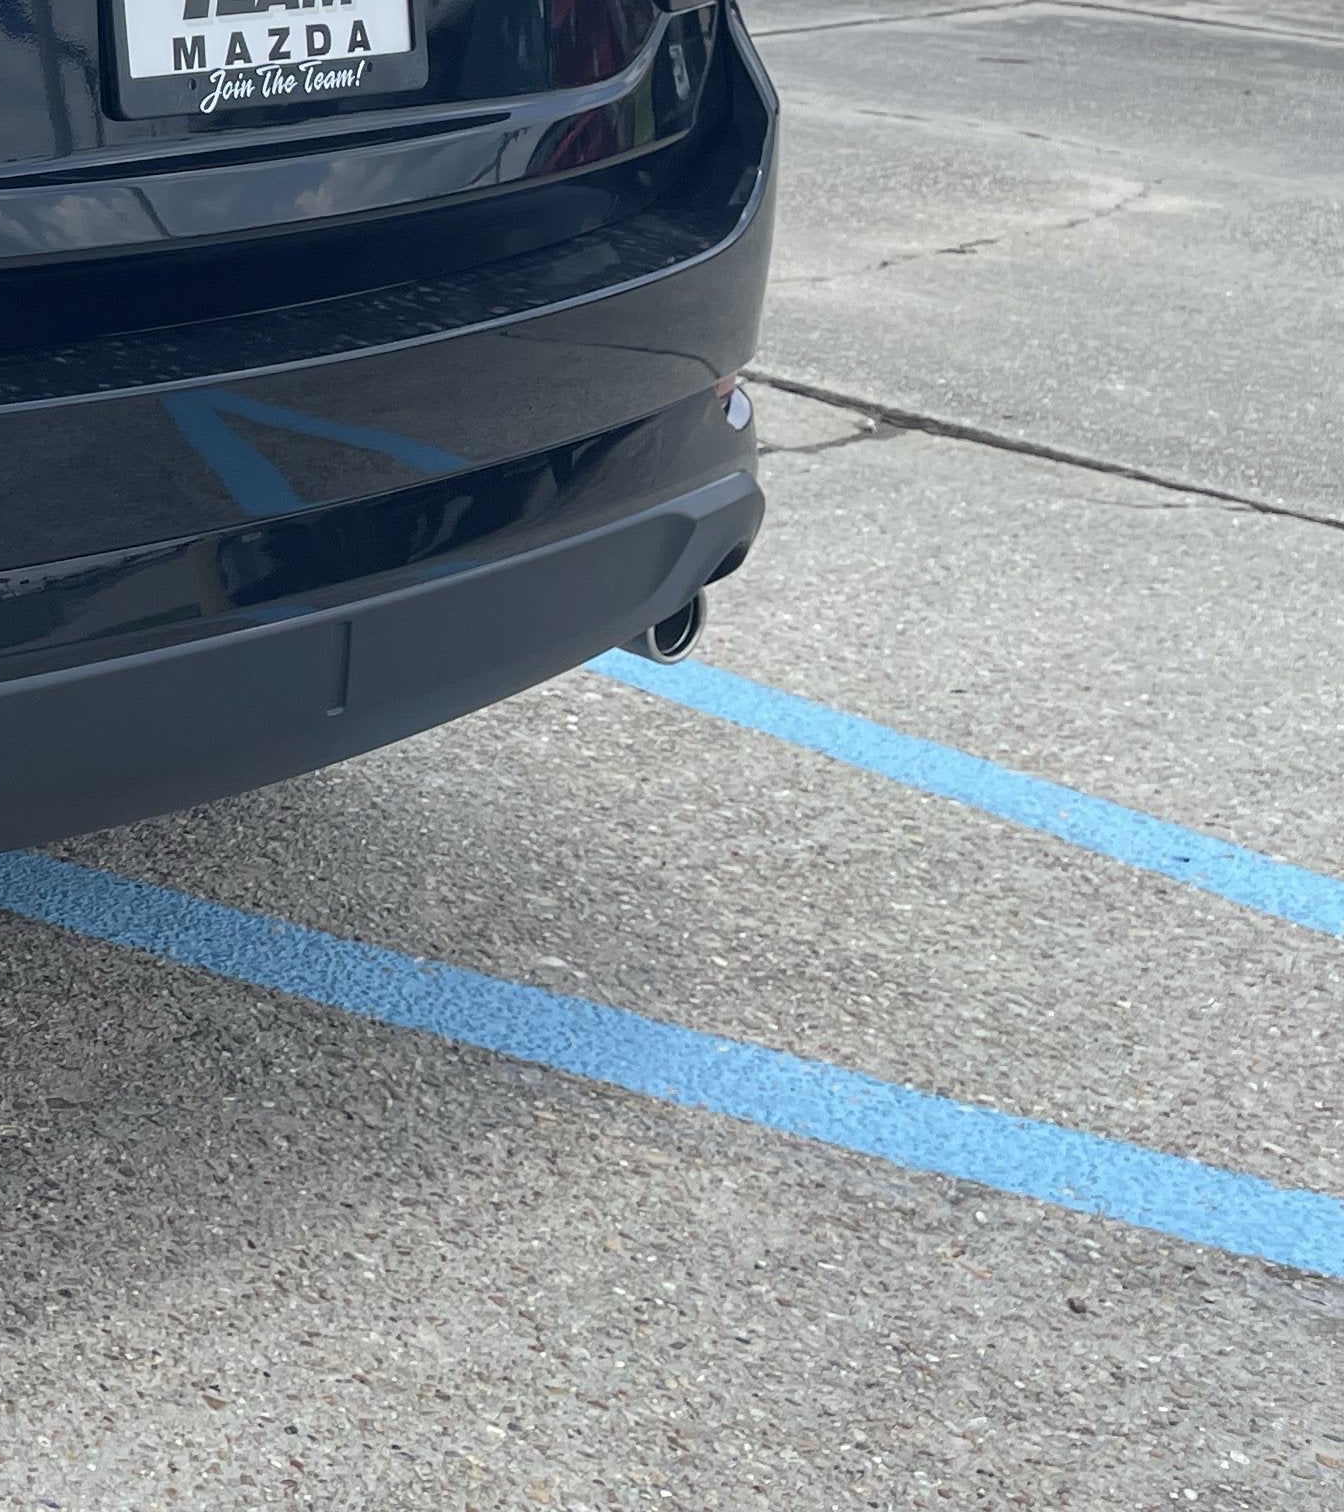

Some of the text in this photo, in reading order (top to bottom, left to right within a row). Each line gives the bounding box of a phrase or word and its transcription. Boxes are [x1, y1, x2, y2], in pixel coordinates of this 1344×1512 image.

[172, 19, 372, 71] MAZDA
[199, 59, 366, 114] Join The Team!
